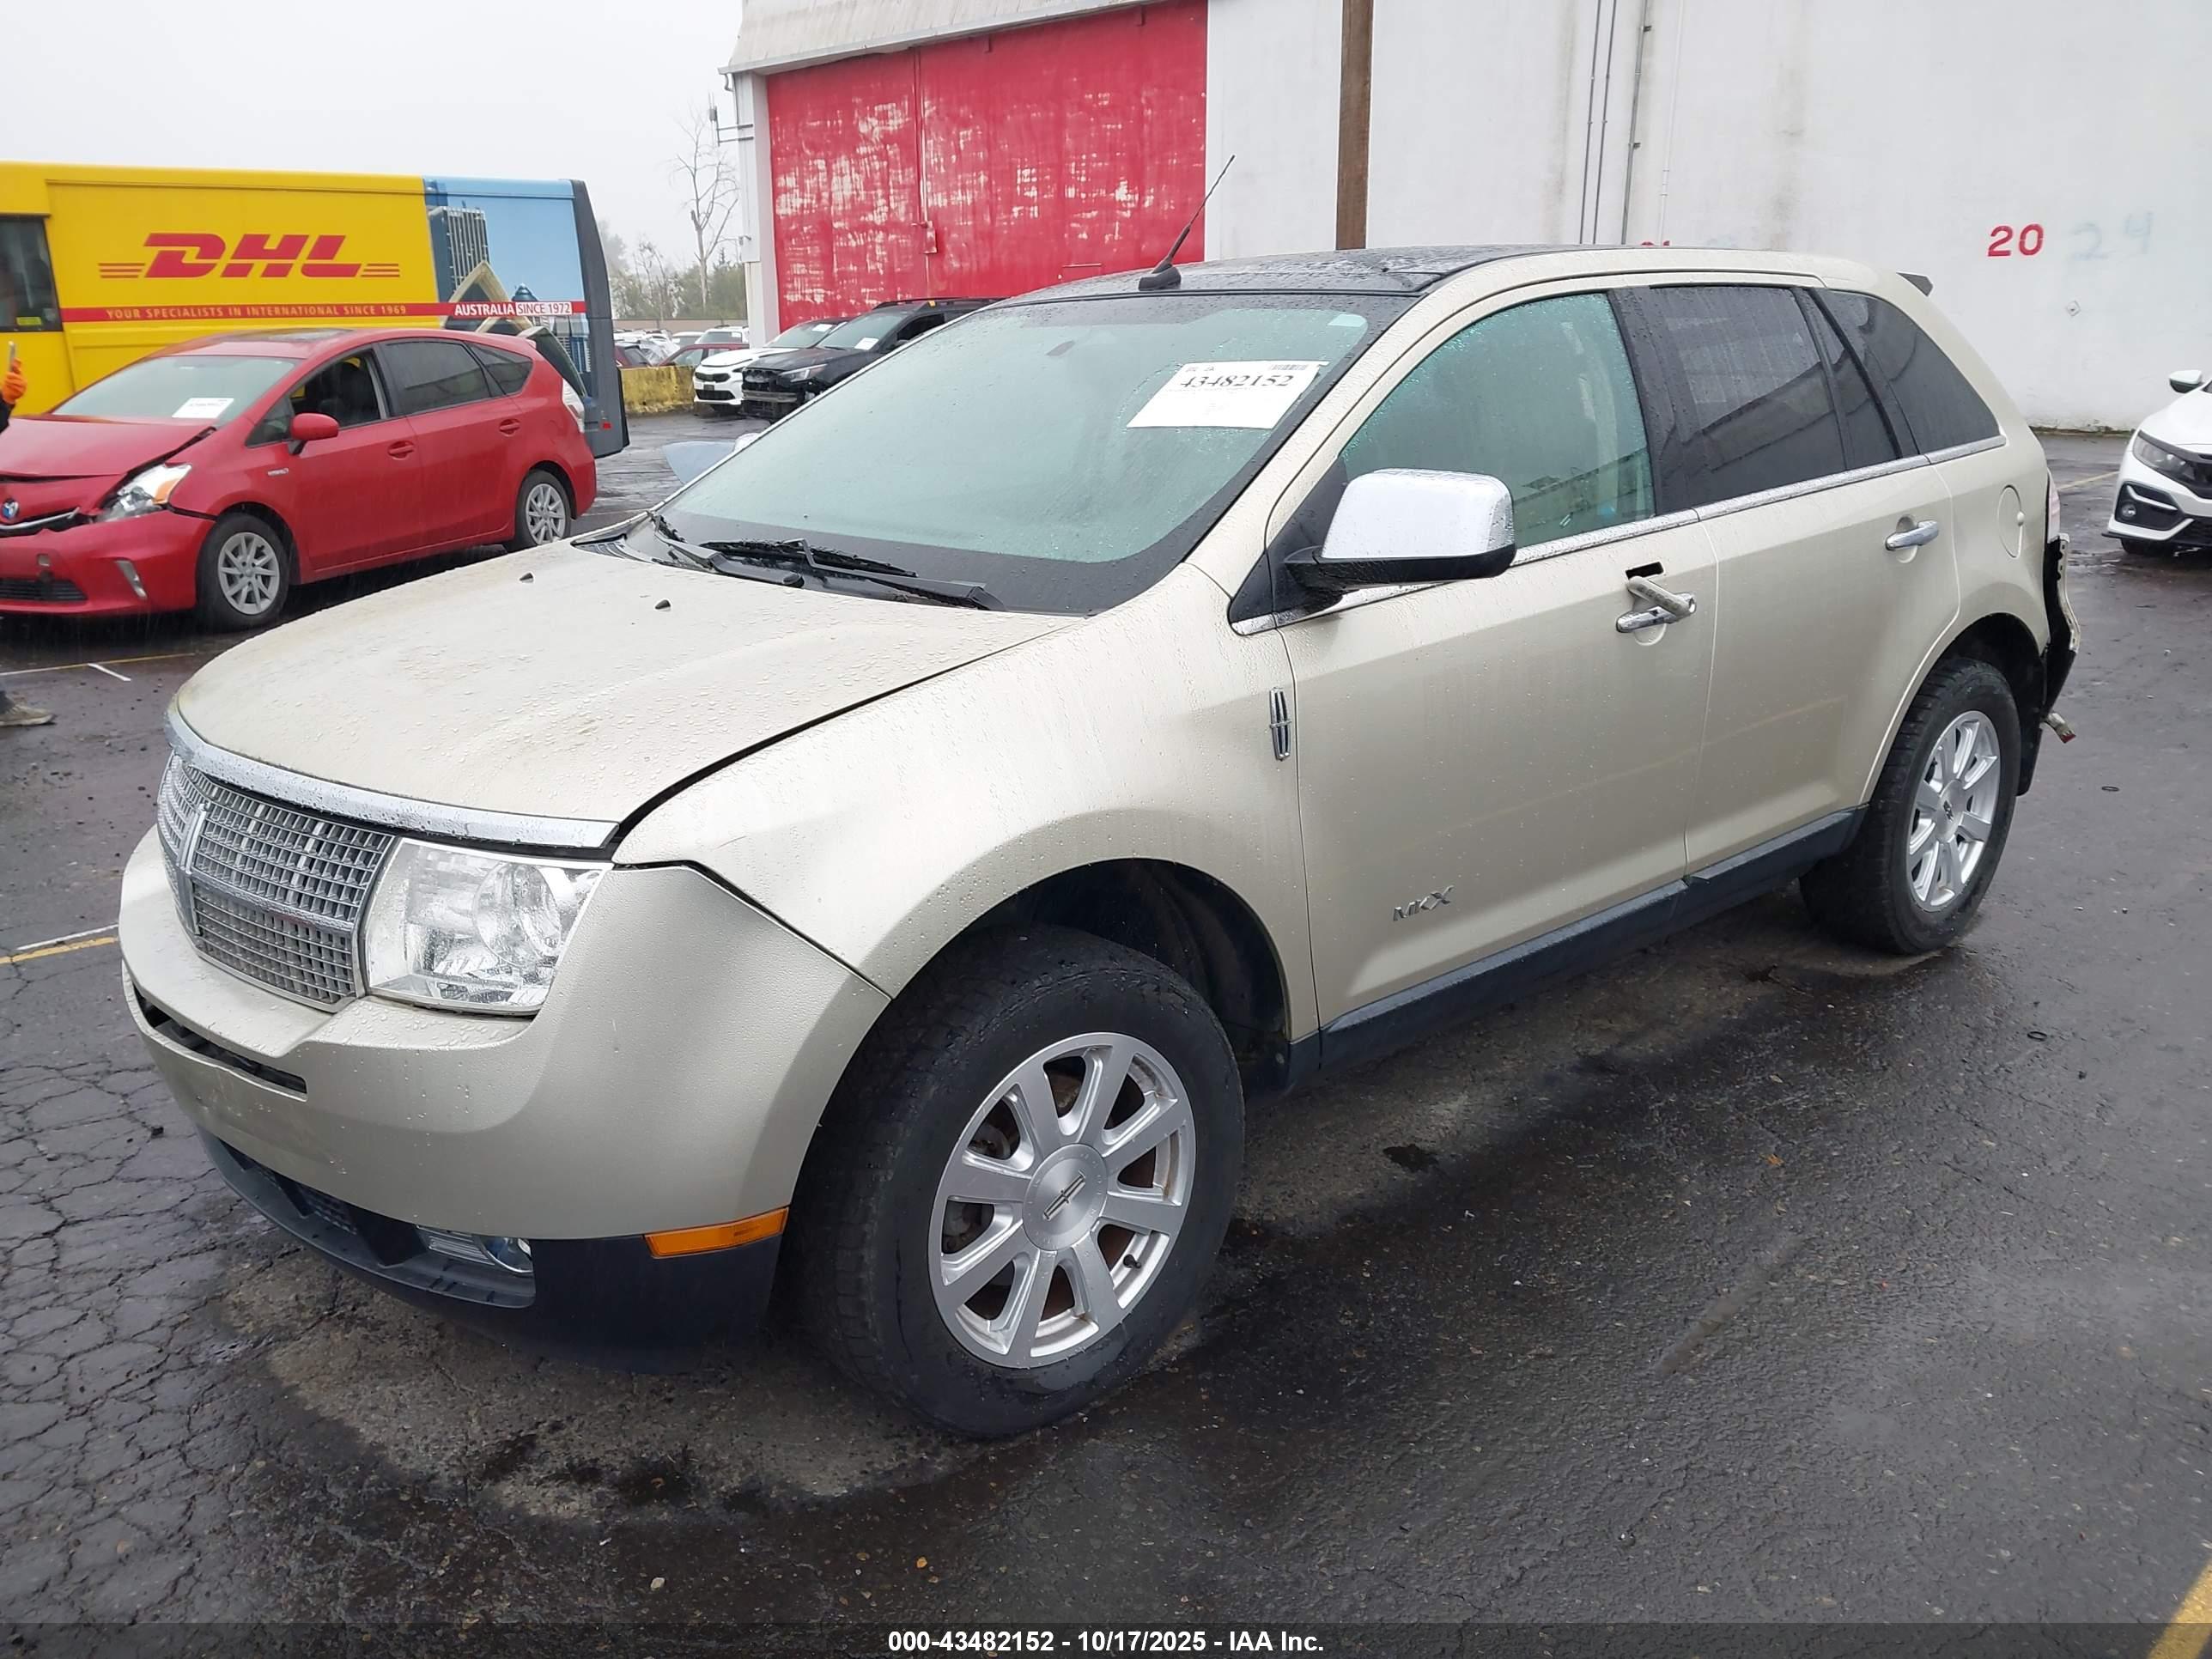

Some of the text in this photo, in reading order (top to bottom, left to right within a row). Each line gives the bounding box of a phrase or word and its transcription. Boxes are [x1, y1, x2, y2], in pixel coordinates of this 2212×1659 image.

[1988, 223, 2044, 257] 20
[143, 233, 362, 278] DHL
[106, 305, 407, 319] YOUR SPECIALISTS IN INTERNATIONAL SINCE 1969
[454, 303, 570, 316] AUSTRALIA SINCE 1972
[1180, 374, 1294, 387] 43482152
[1393, 884, 1455, 921] MKX
